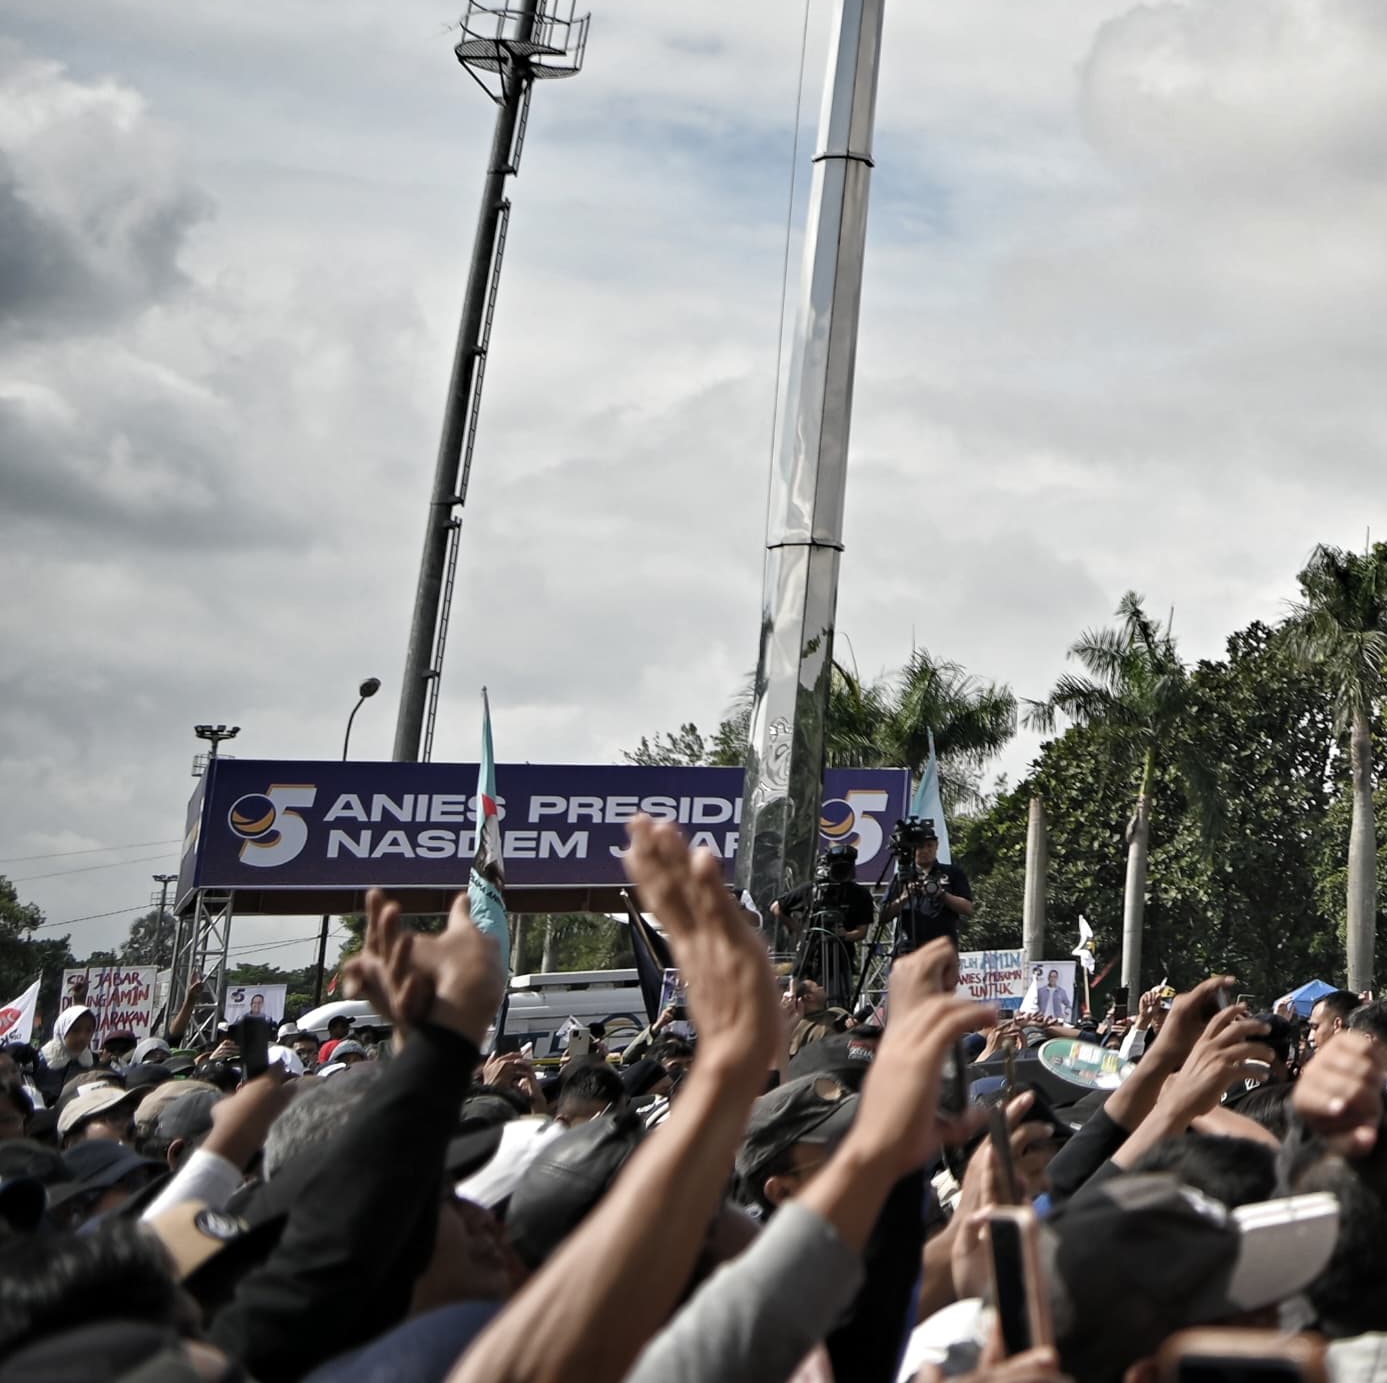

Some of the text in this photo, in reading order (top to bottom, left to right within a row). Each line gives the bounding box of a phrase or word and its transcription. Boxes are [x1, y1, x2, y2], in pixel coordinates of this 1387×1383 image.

[323, 794, 742, 824] ANIES PRESID
[239, 784, 317, 867] 5
[94, 971, 142, 990] JABAR
